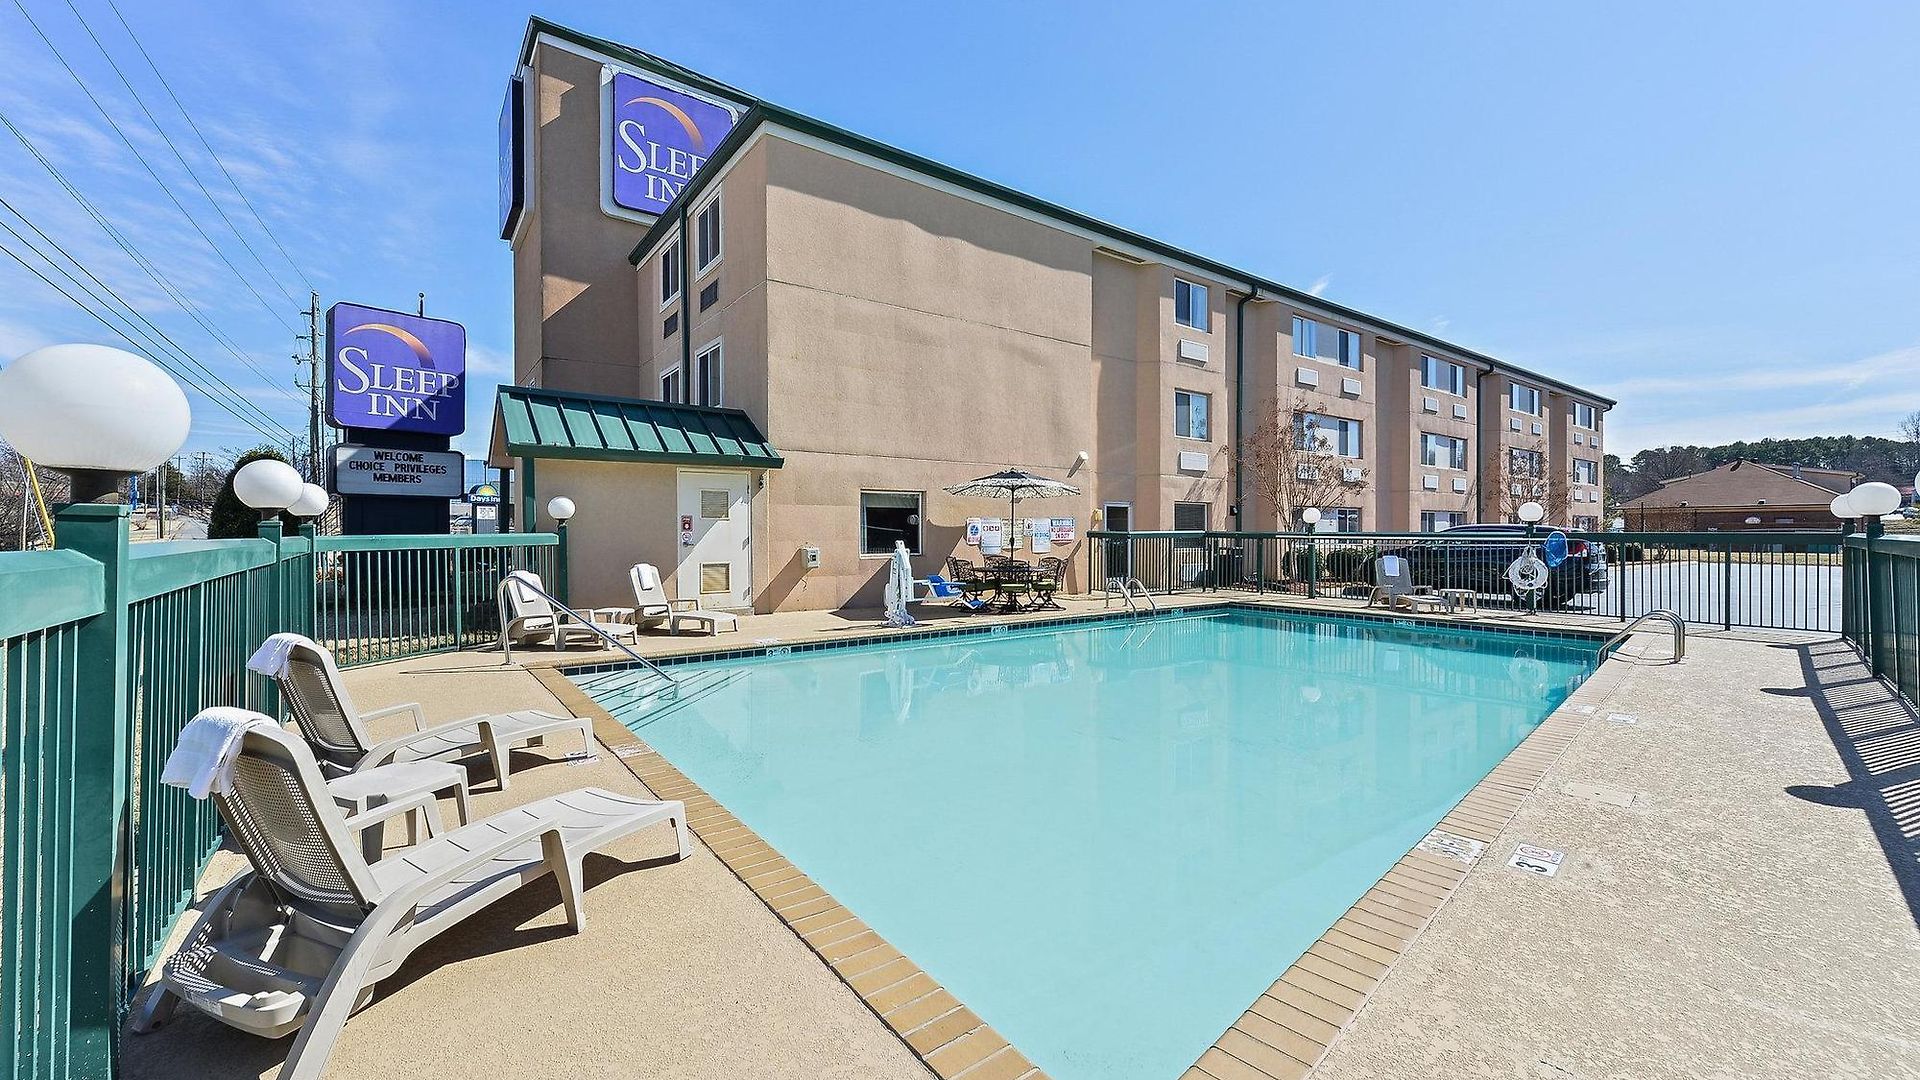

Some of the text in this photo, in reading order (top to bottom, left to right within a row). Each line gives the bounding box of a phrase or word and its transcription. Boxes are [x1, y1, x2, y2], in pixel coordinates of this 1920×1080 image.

[337, 346, 460, 398] SLEEP
[367, 393, 441, 421] INN
[373, 451, 424, 463] WELCOME
[349, 461, 447, 475] CHOICE PRIVILEGES
[372, 473, 422, 484] MEMBERS
